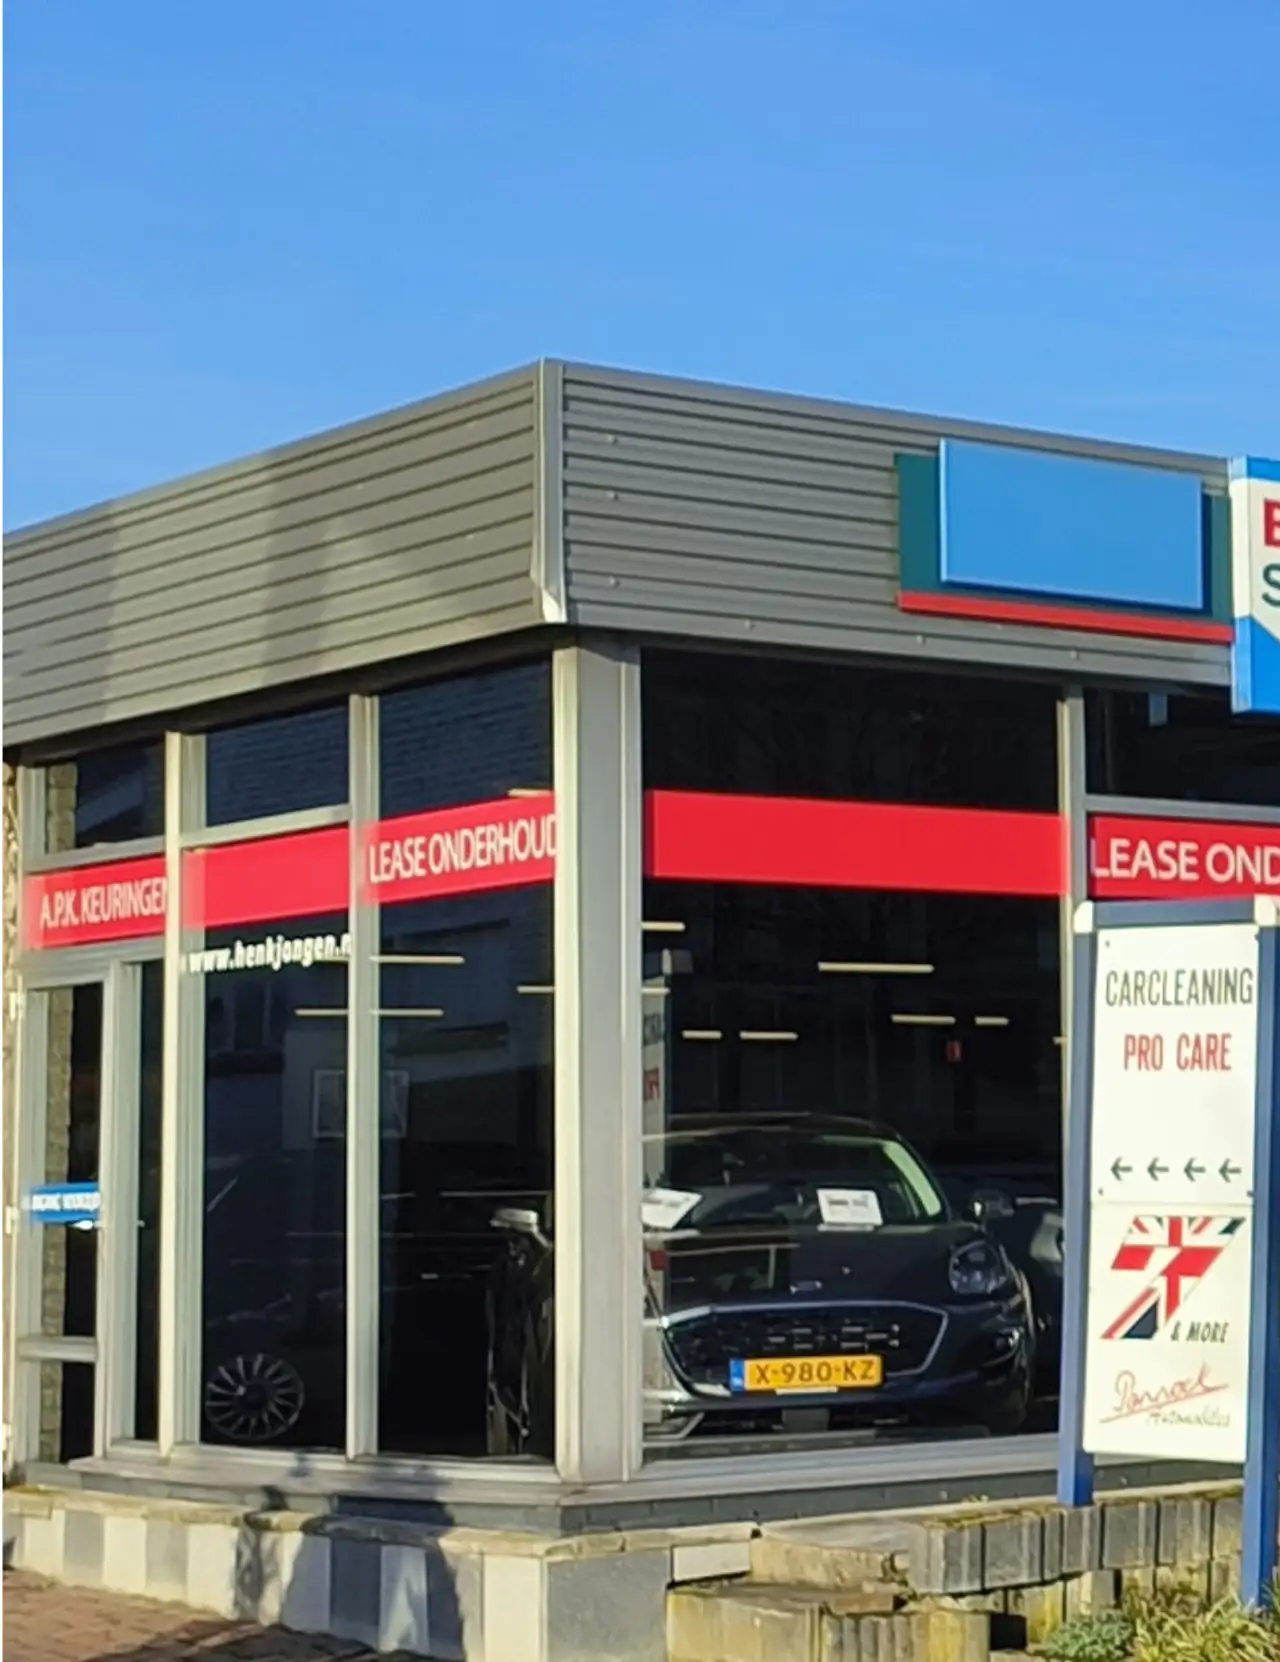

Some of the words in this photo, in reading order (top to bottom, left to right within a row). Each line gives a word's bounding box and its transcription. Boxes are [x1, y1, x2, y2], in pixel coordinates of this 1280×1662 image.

[369, 836, 426, 884] LEASE
[428, 813, 557, 876] ONDERHOUD
[1091, 839, 1199, 881] LEASE
[189, 932, 353, 972] www.henkjongen.n
[1105, 967, 1254, 1007] CARCLEANING
[1124, 1033, 1164, 1072] PRO
[1176, 1032, 1233, 1072] CARE
[1186, 1322, 1229, 1343] MORE
[756, 1360, 876, 1384] X-980-KZ
